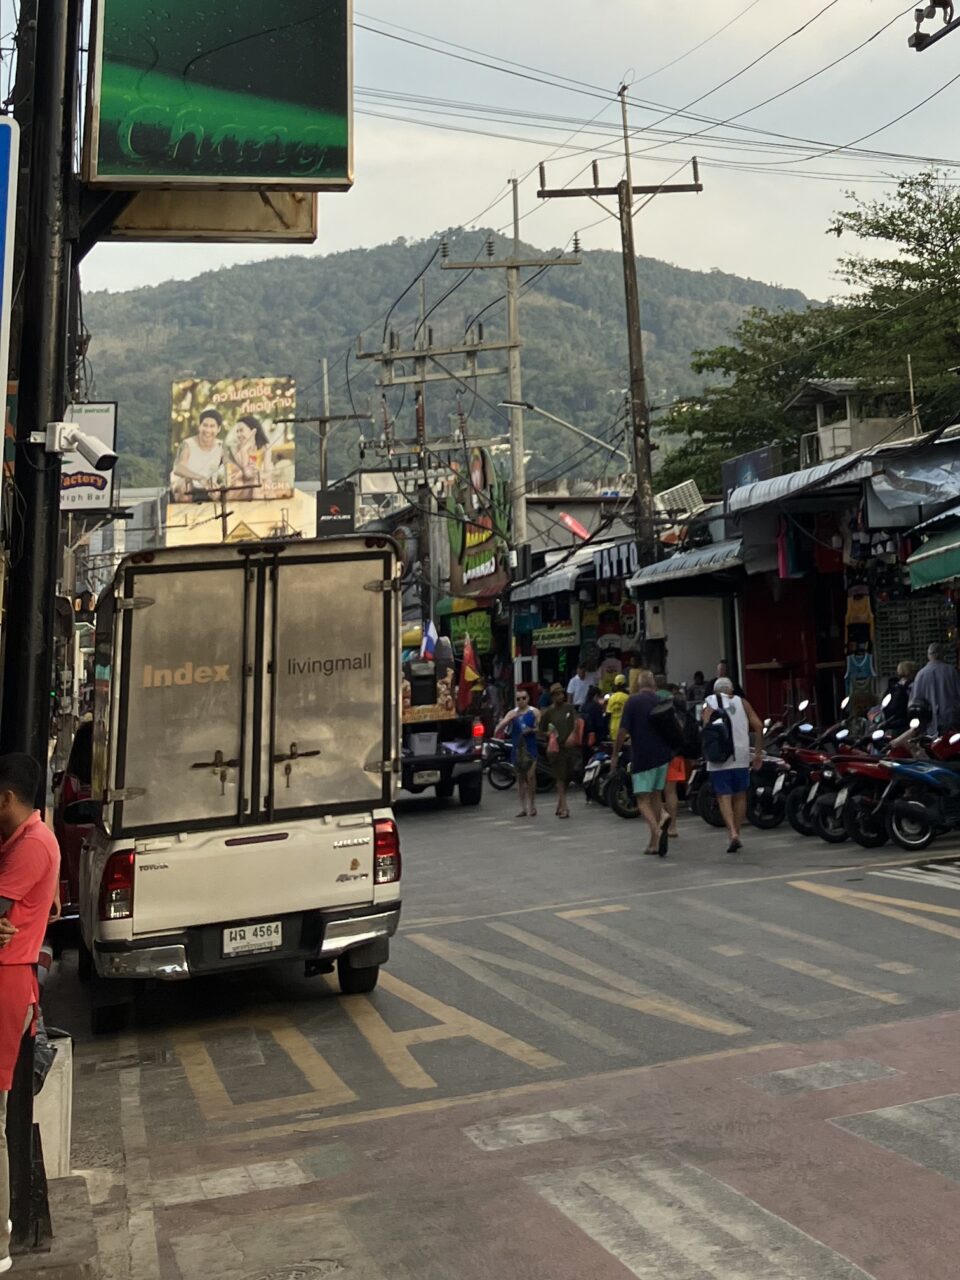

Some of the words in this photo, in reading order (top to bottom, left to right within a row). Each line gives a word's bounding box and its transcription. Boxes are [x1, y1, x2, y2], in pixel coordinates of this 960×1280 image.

[60, 472, 103, 488] actory
[87, 492, 107, 501] Bar
[287, 652, 372, 677] livingmall
[142, 661, 230, 689] Index
[252, 923, 280, 939] 4564
